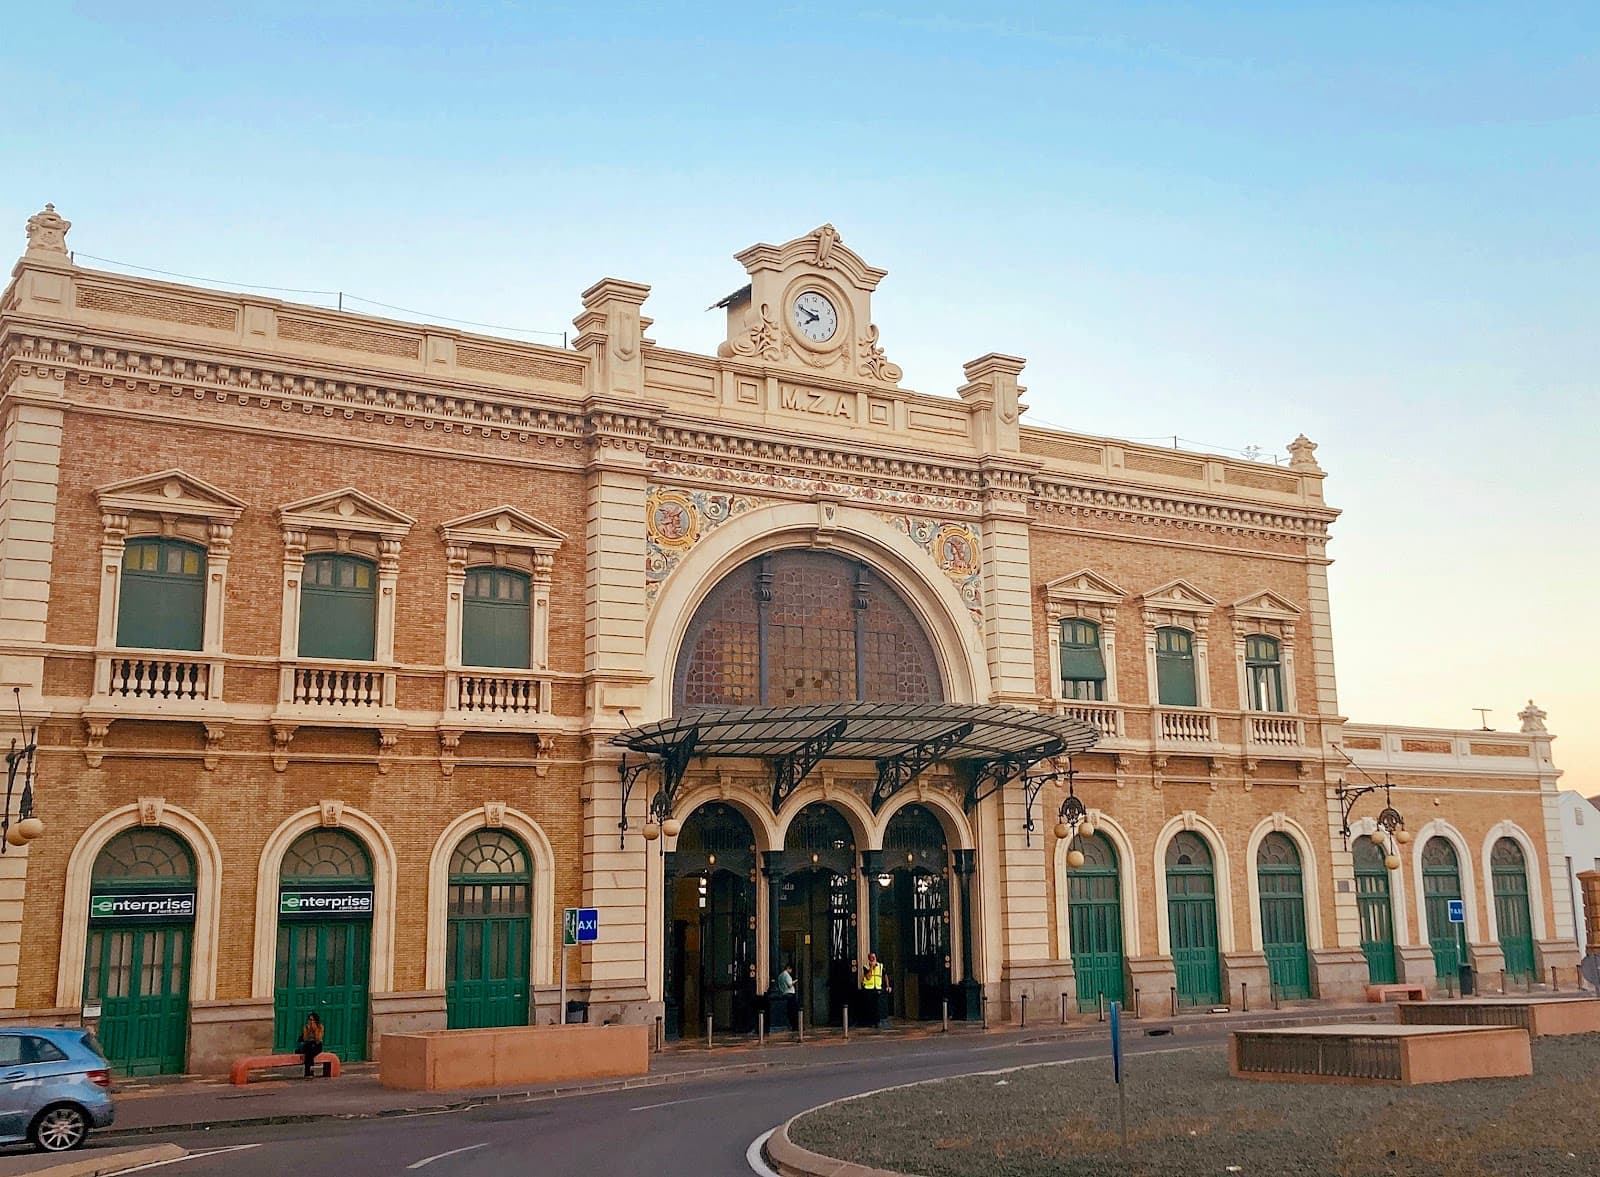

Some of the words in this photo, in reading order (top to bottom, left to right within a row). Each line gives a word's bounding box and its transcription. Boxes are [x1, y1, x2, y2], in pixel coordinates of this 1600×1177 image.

[99, 898, 191, 912] enterprise
[287, 896, 369, 909] enterprise
[578, 920, 597, 930] AXI
